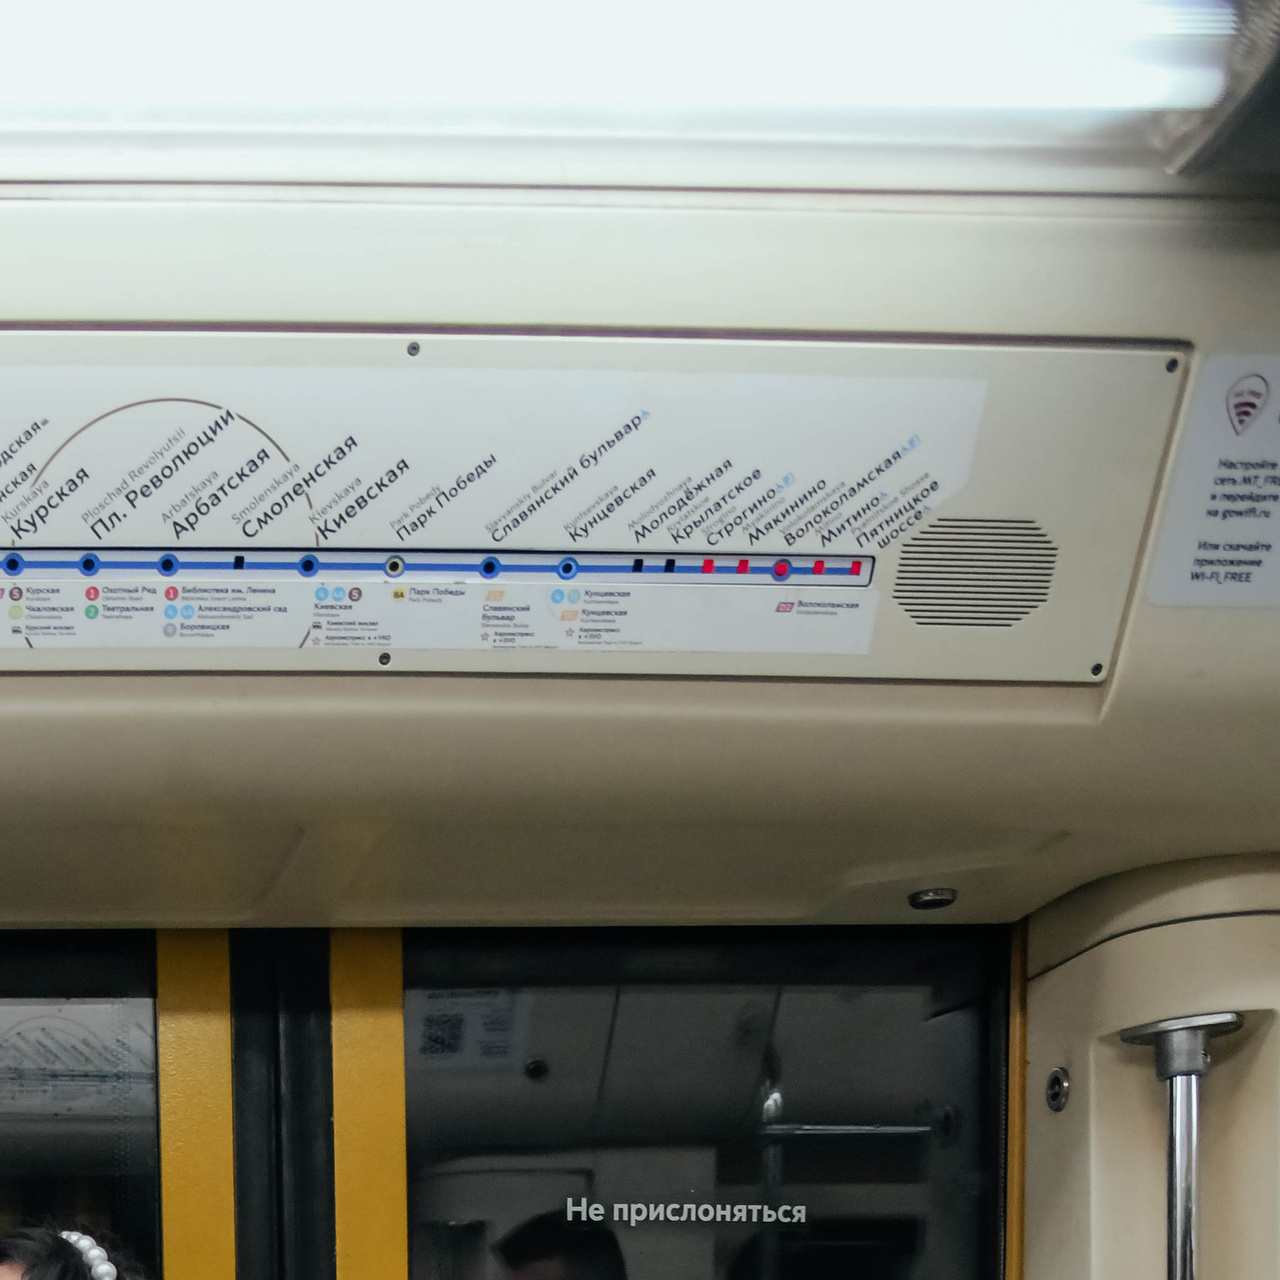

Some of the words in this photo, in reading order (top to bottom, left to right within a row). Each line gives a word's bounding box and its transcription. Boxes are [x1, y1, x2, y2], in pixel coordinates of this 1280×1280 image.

[1, 479, 50, 524] Kurskaya
[10, 467, 90, 540] Курская
[81, 478, 130, 524] Ploschad
[128, 427, 186, 482] Revolyutsii
[90, 510, 127, 540] Пл.
[125, 410, 235, 509] Революции
[161, 470, 220, 524] Arbatskaya
[172, 448, 271, 540] Арбатская
[231, 463, 300, 525] Smolenskaya
[242, 435, 358, 538] Смоленская
[308, 476, 363, 525] Kievskaya
[317, 458, 410, 540] Киевская
[396, 507, 438, 542] Парк
[435, 454, 497, 508] Победы
[491, 465, 579, 543] Славянский
[579, 415, 642, 469] бульвар
[569, 468, 657, 543] Кунцевская
[635, 459, 733, 543] Молодёжная
[671, 469, 761, 544] Крылатское
[783, 450, 902, 547] Волоколамская
[706, 489, 776, 545] Строгино
[748, 479, 826, 546] Мякинино
[821, 497, 880, 548] Митино
[856, 480, 939, 548] Пятницкое
[877, 509, 923, 549] шоссе
[566, 1197, 605, 1222] Не
[613, 1202, 807, 1227] прислоняться
